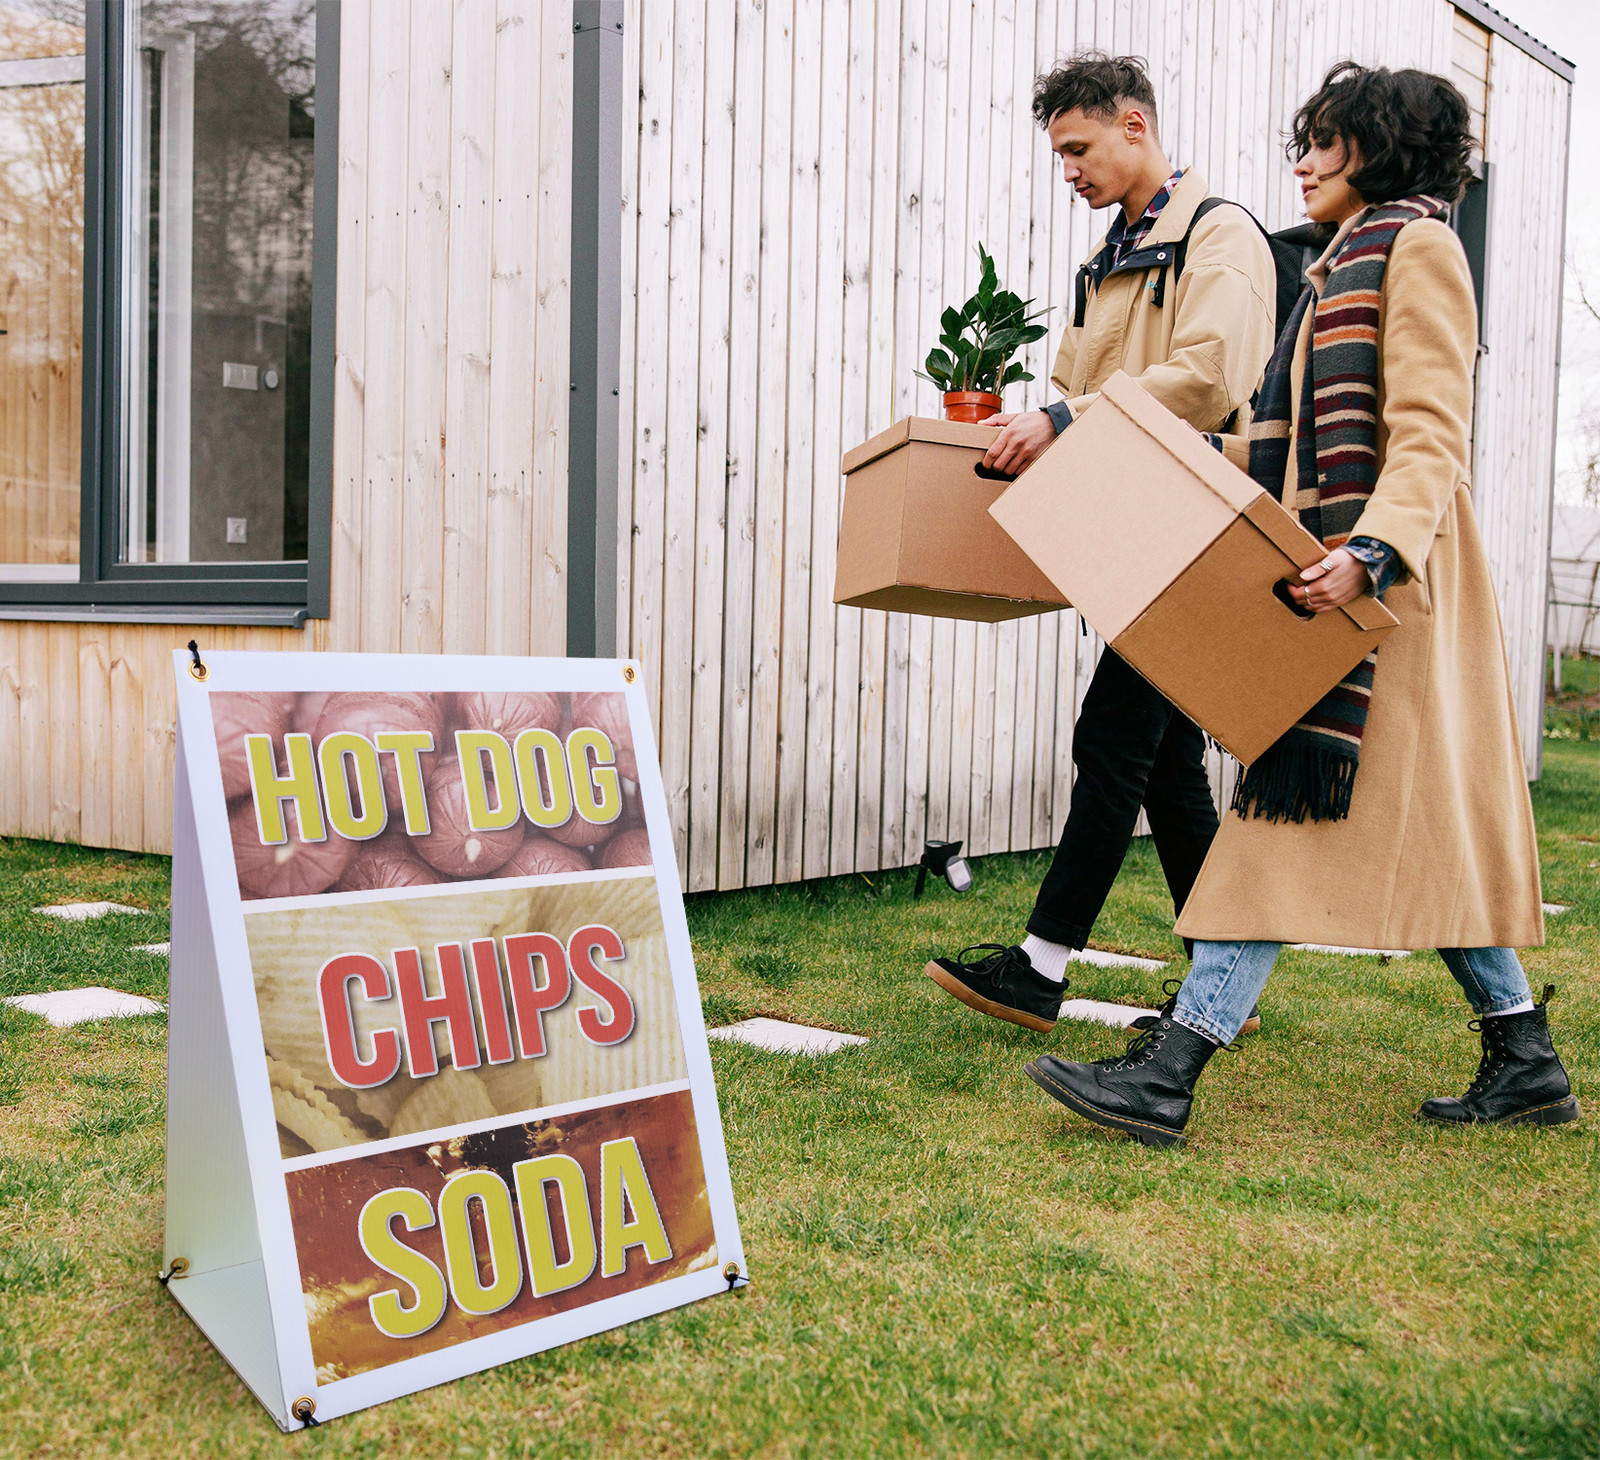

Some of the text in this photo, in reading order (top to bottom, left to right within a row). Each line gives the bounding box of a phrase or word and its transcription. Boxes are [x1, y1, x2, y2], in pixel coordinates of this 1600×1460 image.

[244, 728, 622, 845] HOT DOG
[317, 925, 635, 1088] CHIPS
[359, 1137, 672, 1337] SODA
